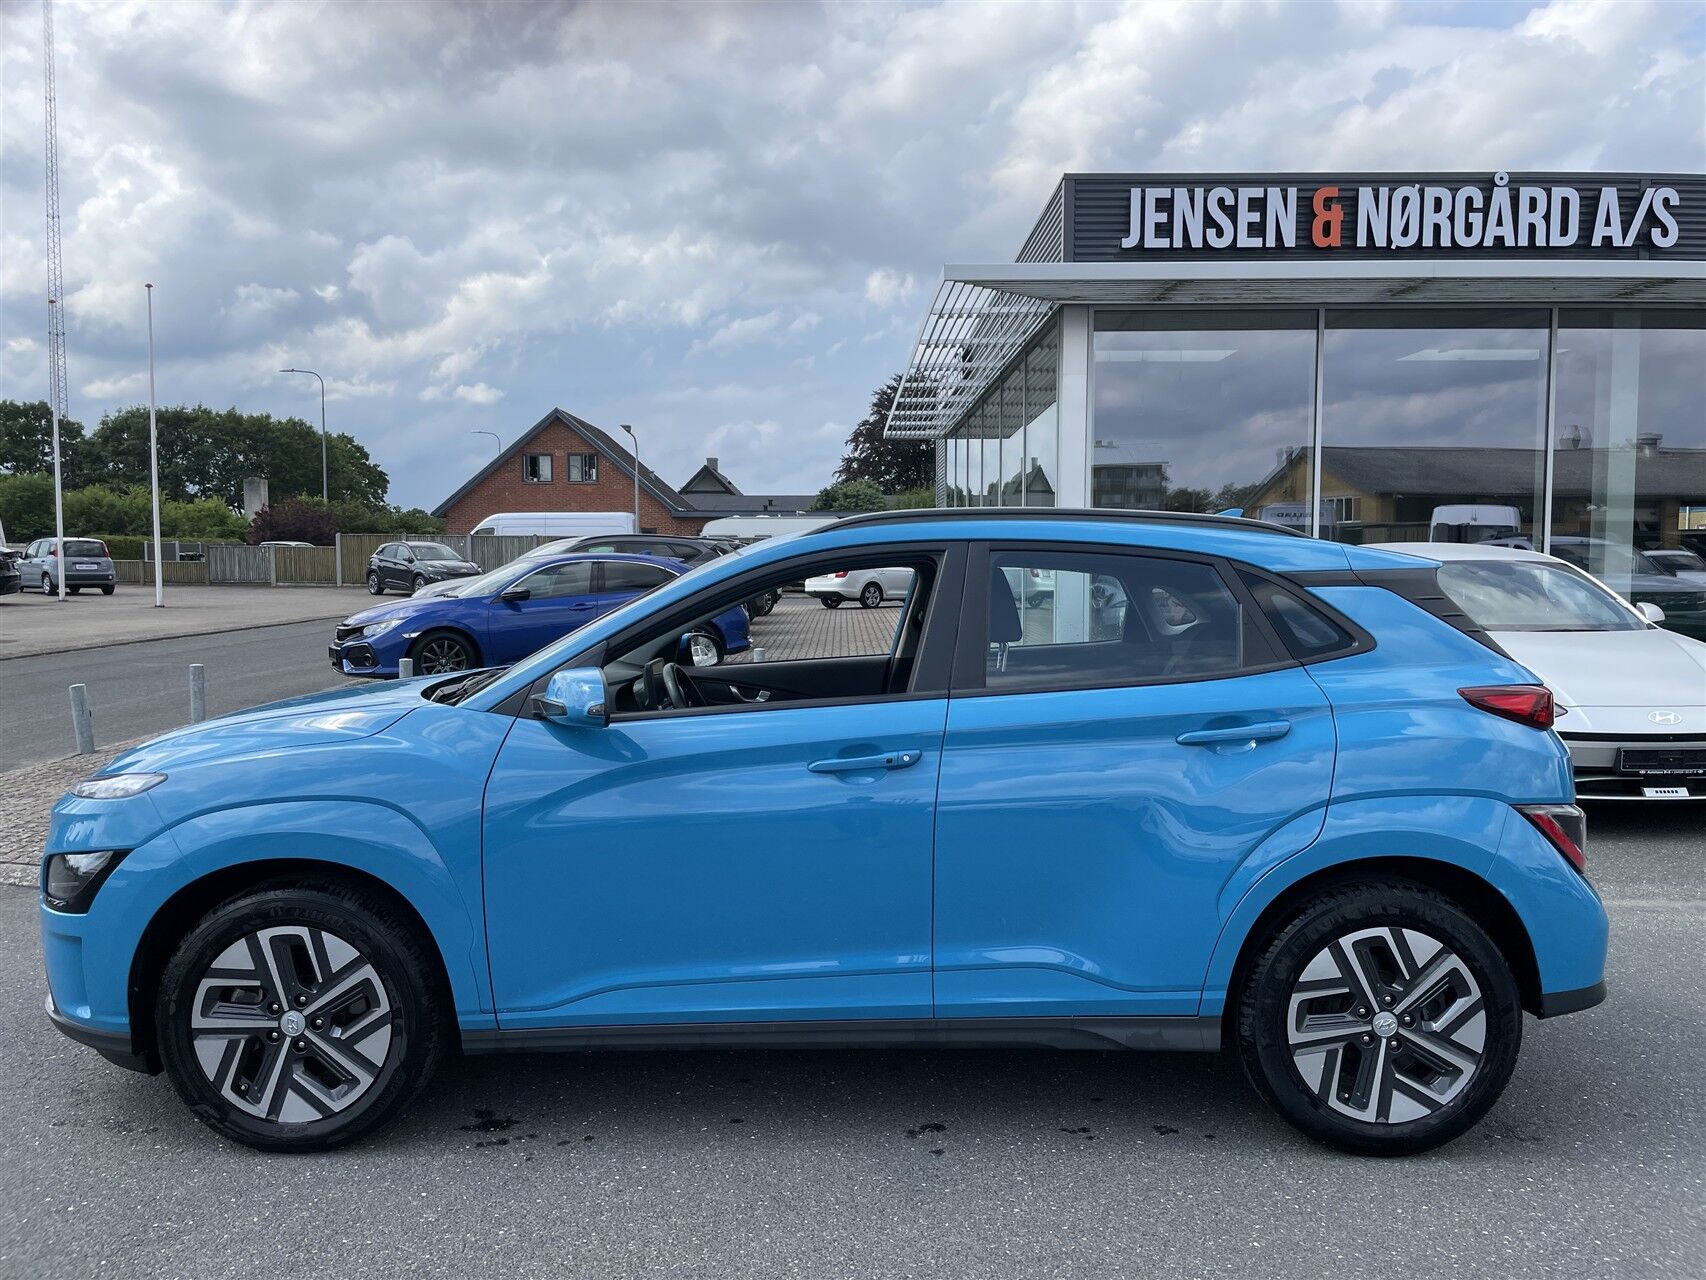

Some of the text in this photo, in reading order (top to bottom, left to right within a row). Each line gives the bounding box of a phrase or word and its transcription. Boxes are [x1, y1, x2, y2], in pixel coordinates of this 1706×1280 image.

[1121, 171, 1680, 250] JENSEN & NØRGÅRD A/S
